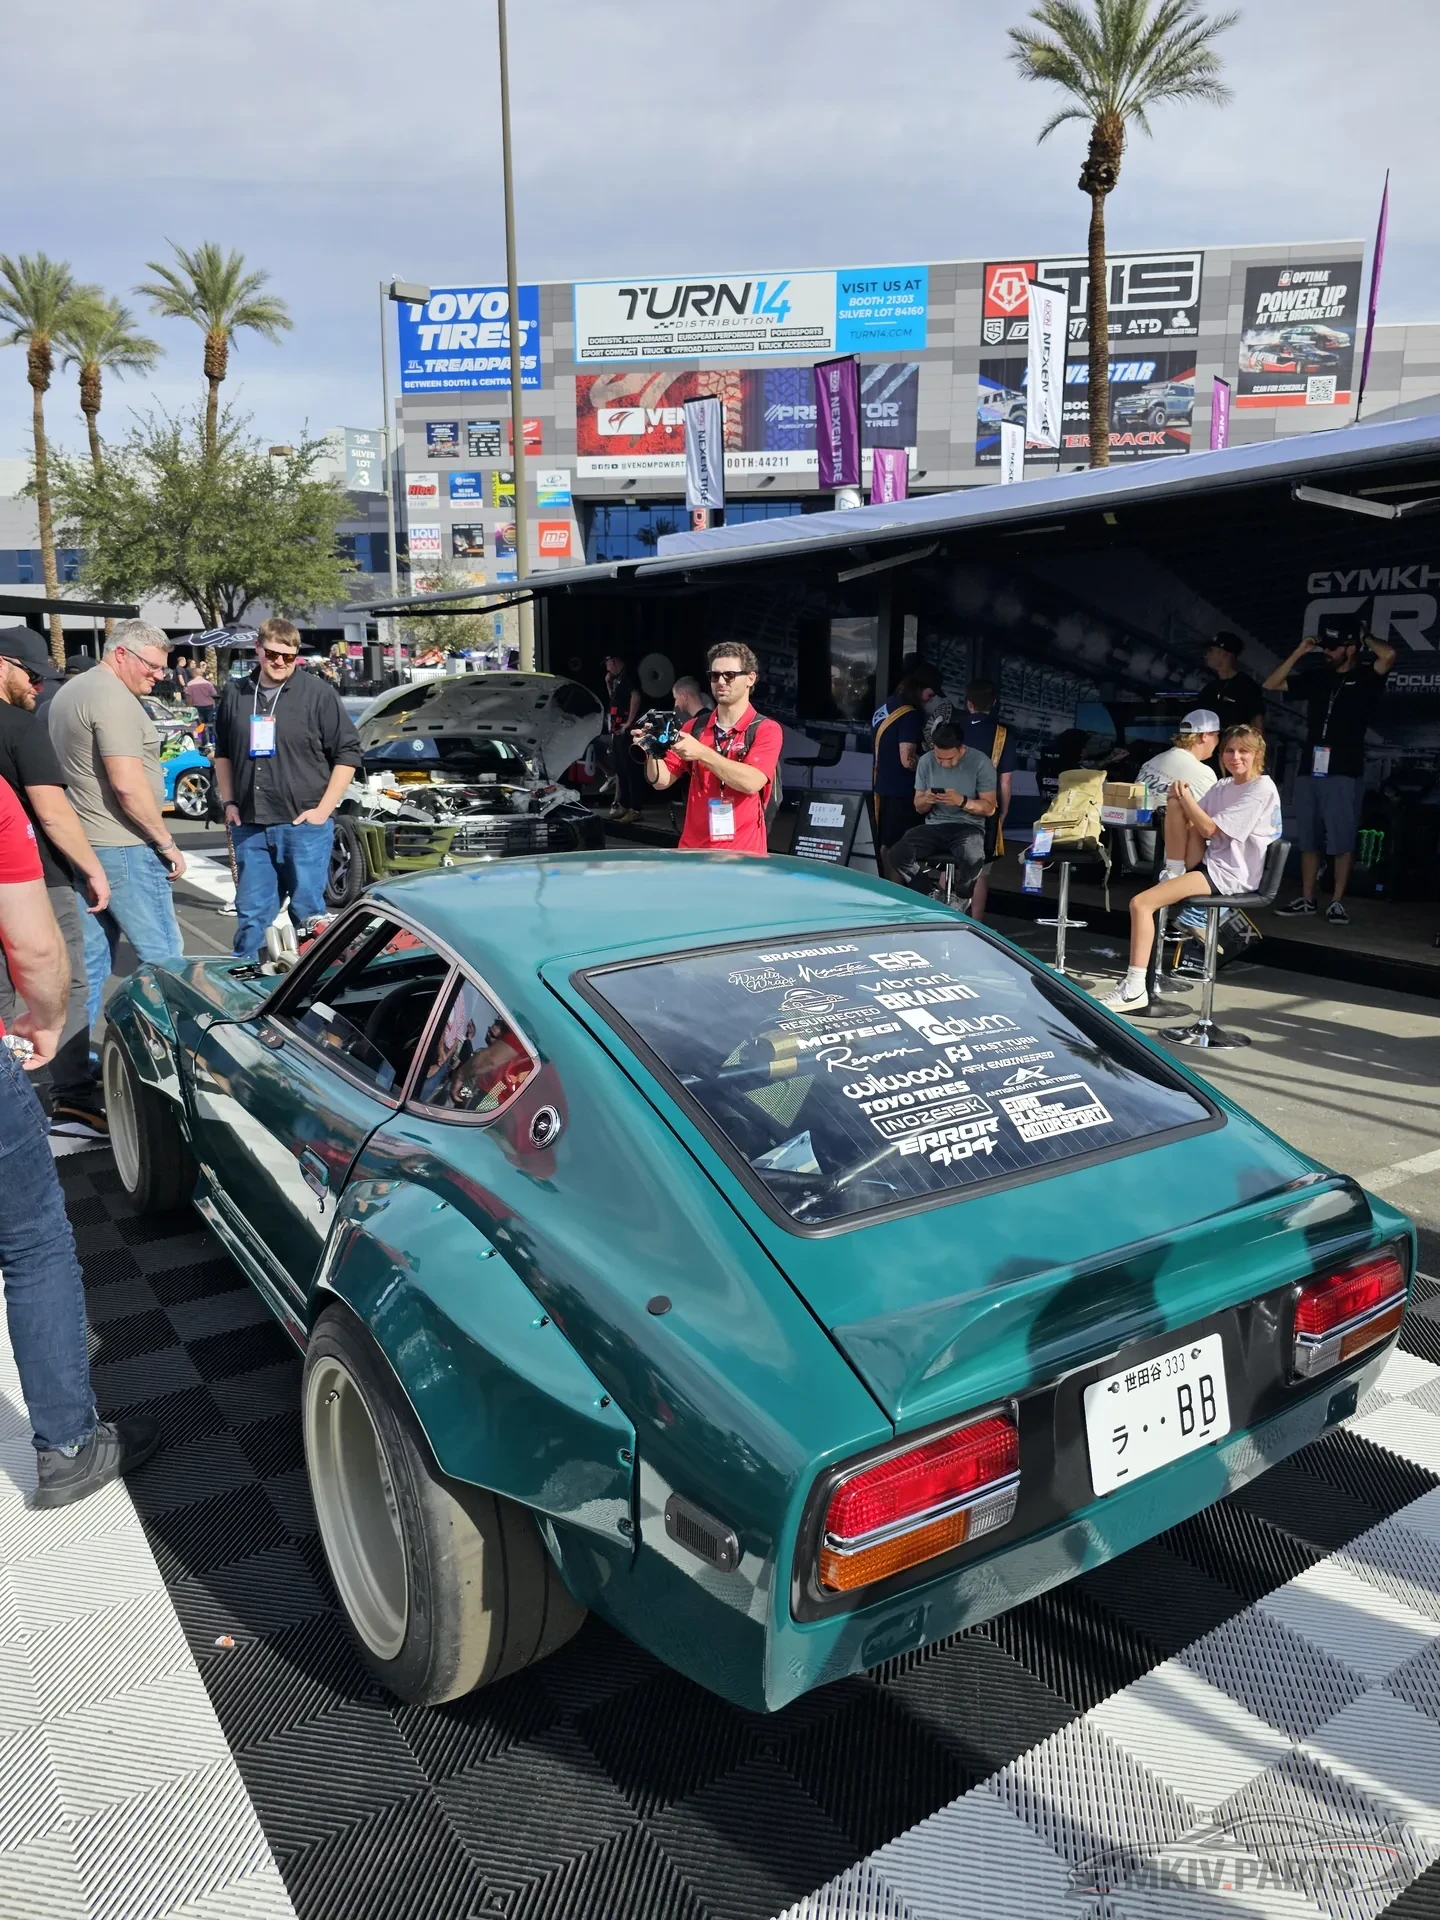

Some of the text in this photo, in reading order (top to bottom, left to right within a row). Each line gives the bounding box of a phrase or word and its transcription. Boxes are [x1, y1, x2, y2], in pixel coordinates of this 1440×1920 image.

[1292, 270, 1329, 283] OPTIMA
[842, 280, 922, 293] VISIT US AT
[406, 291, 509, 322] TOYO
[618, 280, 792, 323] TURN14
[849, 294, 914, 306] BOOTH 21303
[1256, 285, 1347, 313] POWER UP
[675, 317, 774, 328] DISTRIBUTION
[839, 309, 872, 319] SILVER
[874, 308, 894, 317] LOT
[1255, 305, 1345, 325] AT THE BRONZE LOT
[417, 321, 531, 350] TIRES
[716, 330, 766, 338] PERFORMANCE
[850, 328, 912, 339] TURN14.COM
[1126, 319, 1162, 334] ATD
[624, 335, 673, 343] PERFORMANCE
[760, 341, 782, 349] TRUCK
[605, 348, 637, 356] COMPACT
[425, 356, 537, 373] TREADPAS
[404, 380, 441, 388] BETWEEN
[443, 379, 470, 387] SOUTH
[471, 378, 479, 386] &
[480, 378, 511, 386] CENTRA
[865, 419, 899, 428] TIRES
[830, 396, 843, 483] NEXEN TIRE
[351, 449, 376, 460] SILVER
[697, 430, 708, 473] NEXEN
[356, 459, 371, 468] LOT
[726, 456, 790, 468] OOTH:44211
[358, 470, 370, 486] 3
[410, 528, 439, 539] LIQUI
[410, 539, 440, 550] MOLY
[758, 944, 860, 963] BRADBUILDS
[858, 972, 959, 992] vibrant
[874, 984, 980, 1010] BRAUM
[779, 1007, 881, 1031] RESURRECTED
[805, 1017, 873, 1034] CLASSICS
[917, 1014, 1017, 1039] radium
[795, 1022, 903, 1050] MOTEGI
[971, 1036, 1039, 1053] FAST TURN
[816, 1046, 924, 1073] Renown
[842, 1059, 954, 1099] wilwood
[985, 1073, 1082, 1098] ANTIGRAVITY BATTERIES
[858, 1080, 971, 1115] TOYO TIRES
[1001, 1096, 1041, 1113] EURO
[1008, 1102, 1067, 1125] CLASSIC
[1017, 1107, 1105, 1140] MOTORSPORT
[890, 1117, 1001, 1156] ERROR
[930, 1139, 998, 1167] 404
[1124, 1353, 1186, 1393] 世田谷 333
[1112, 1424, 1129, 1455] ラ
[1176, 1374, 1217, 1437] BB
